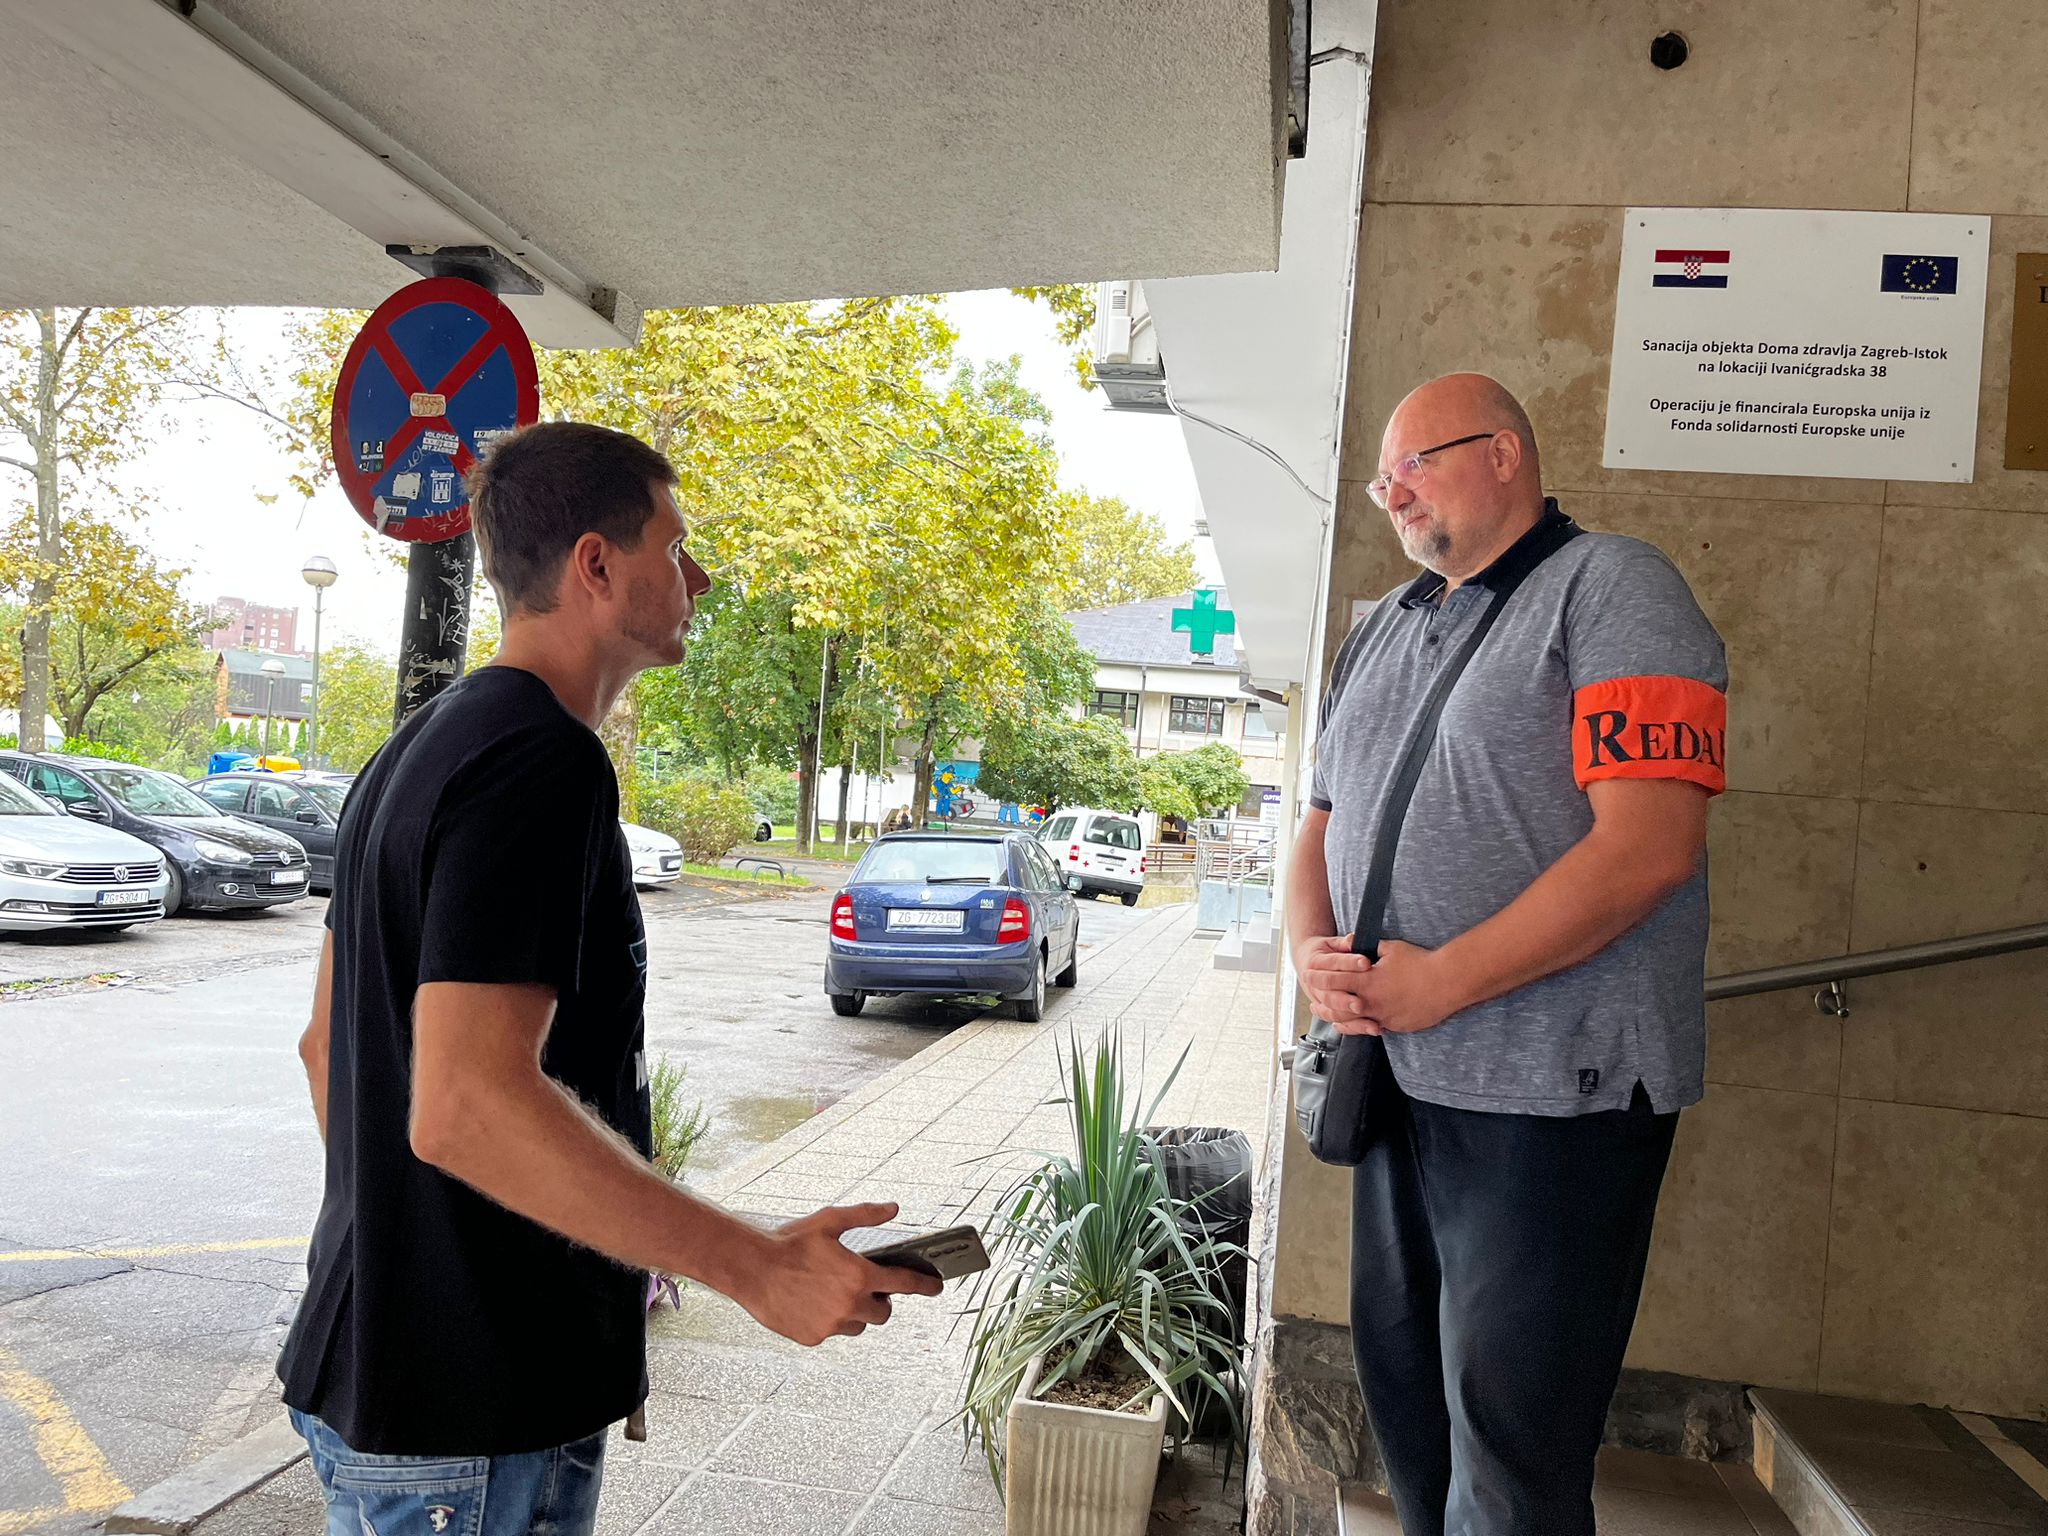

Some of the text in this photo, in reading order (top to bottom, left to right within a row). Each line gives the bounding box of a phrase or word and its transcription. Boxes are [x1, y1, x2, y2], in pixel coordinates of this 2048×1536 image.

[1642, 339, 1948, 361] Sanacija objekta Doma zdravlja Zagreb-Istok
[1698, 360, 1887, 378] na lokaciji Ivanićgradska 38
[1649, 398, 1931, 422] Operaciju je financirala Europska unija iz
[1670, 418, 1906, 441] Fonda solidarnosti Europske unije
